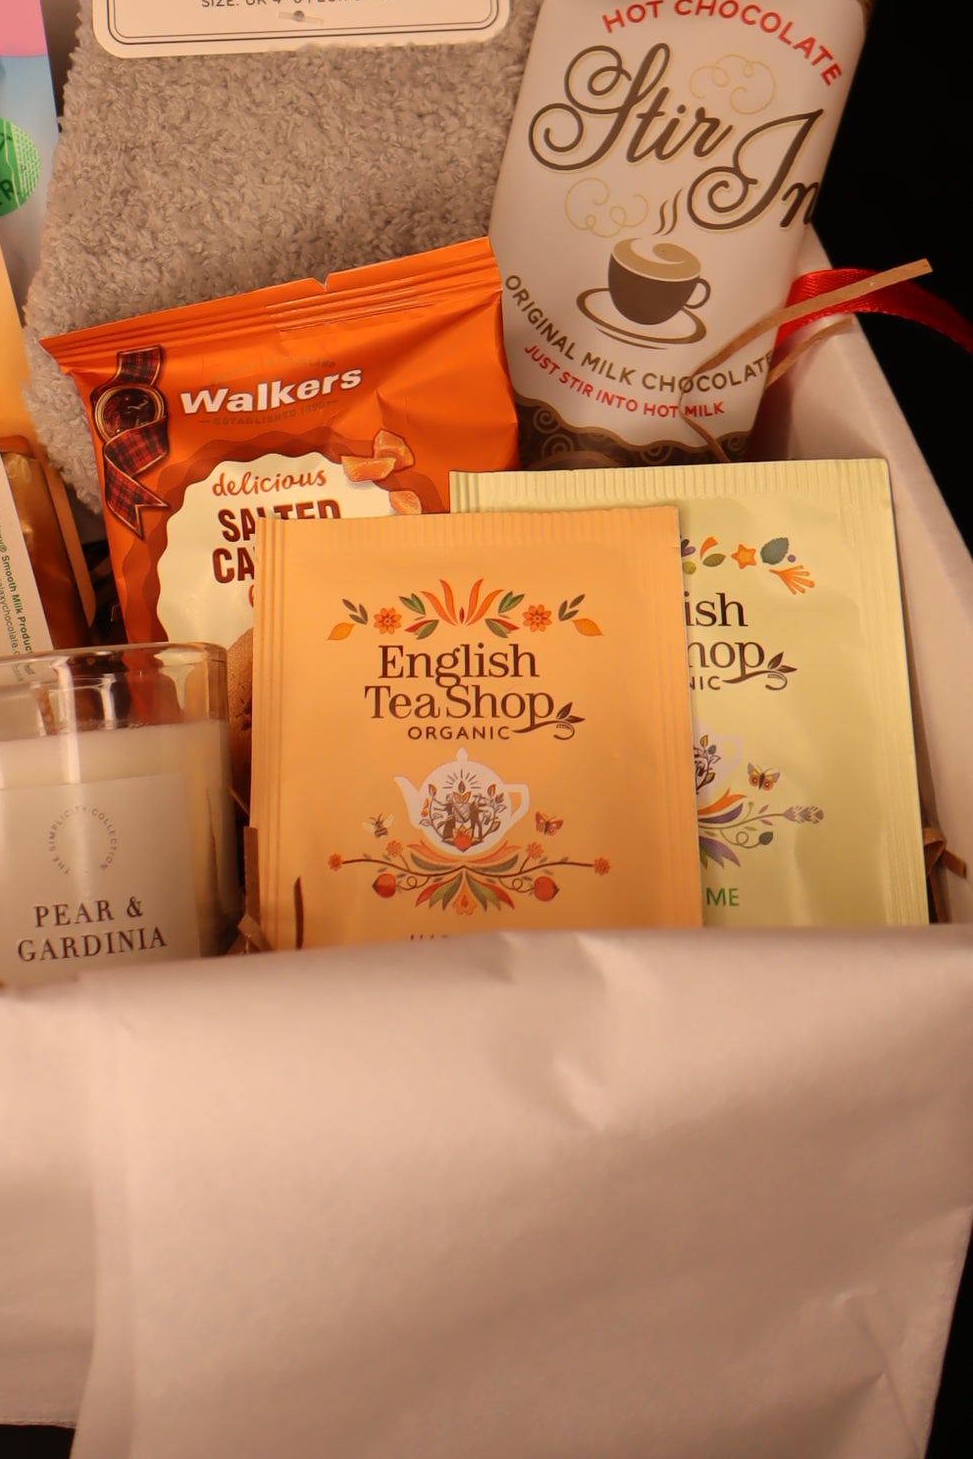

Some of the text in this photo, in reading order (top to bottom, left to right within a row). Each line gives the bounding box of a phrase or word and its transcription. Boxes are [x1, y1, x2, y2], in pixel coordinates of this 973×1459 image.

[602, 0, 664, 34] HOT
[528, 42, 732, 172] Stir
[506, 275, 575, 361] ORIGINAL
[581, 351, 637, 387] MILK
[180, 368, 362, 414] Walkers
[524, 344, 724, 418] JUST STIR INTO HOT MILK
[212, 470, 327, 496] delicious
[2, 555, 17, 592] Smooth
[12, 594, 23, 614] Milk
[378, 642, 539, 689] English
[408, 725, 510, 741] ORGANIC
[33, 896, 143, 928] PEAR &
[17, 926, 168, 962] GARDINIA
